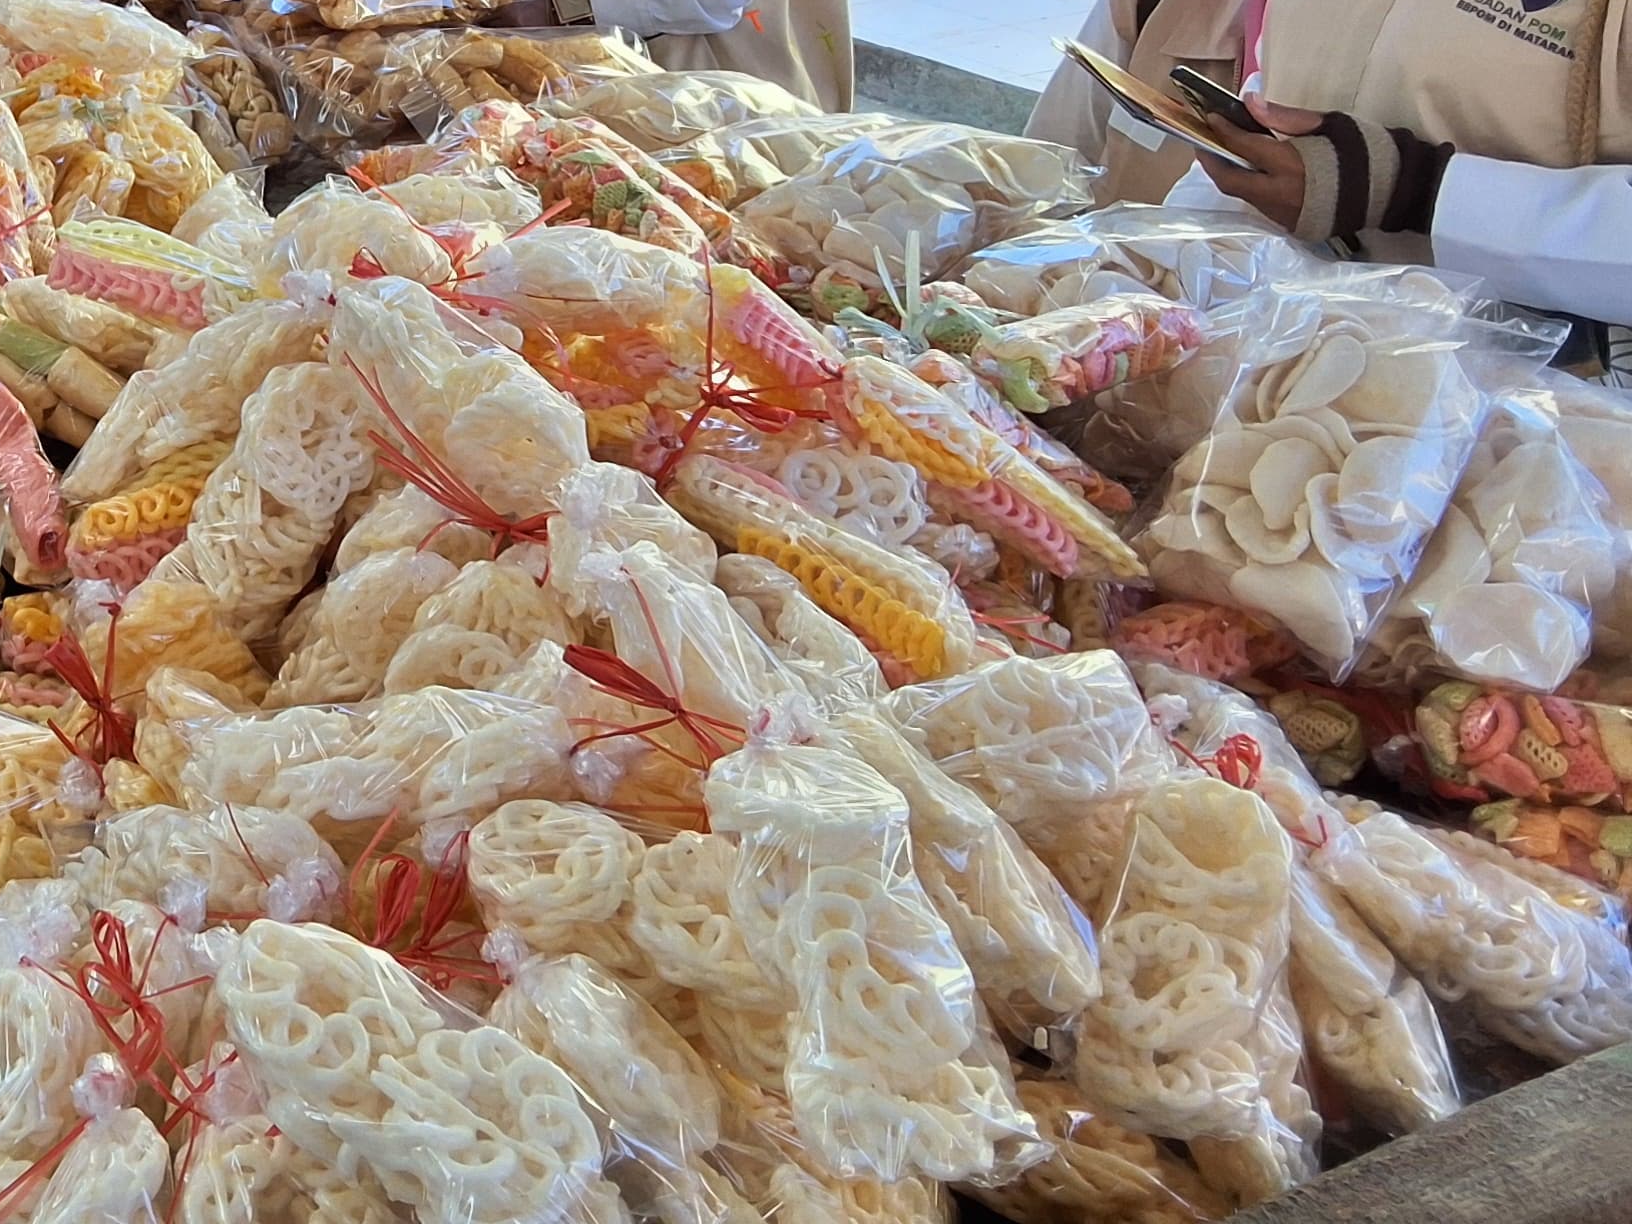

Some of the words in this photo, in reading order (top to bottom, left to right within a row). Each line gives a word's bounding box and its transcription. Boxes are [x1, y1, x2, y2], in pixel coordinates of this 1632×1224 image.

[1455, 0, 1497, 25] BBPOM
[1497, 19, 1513, 33] DI
[1528, 17, 1567, 41] POM
